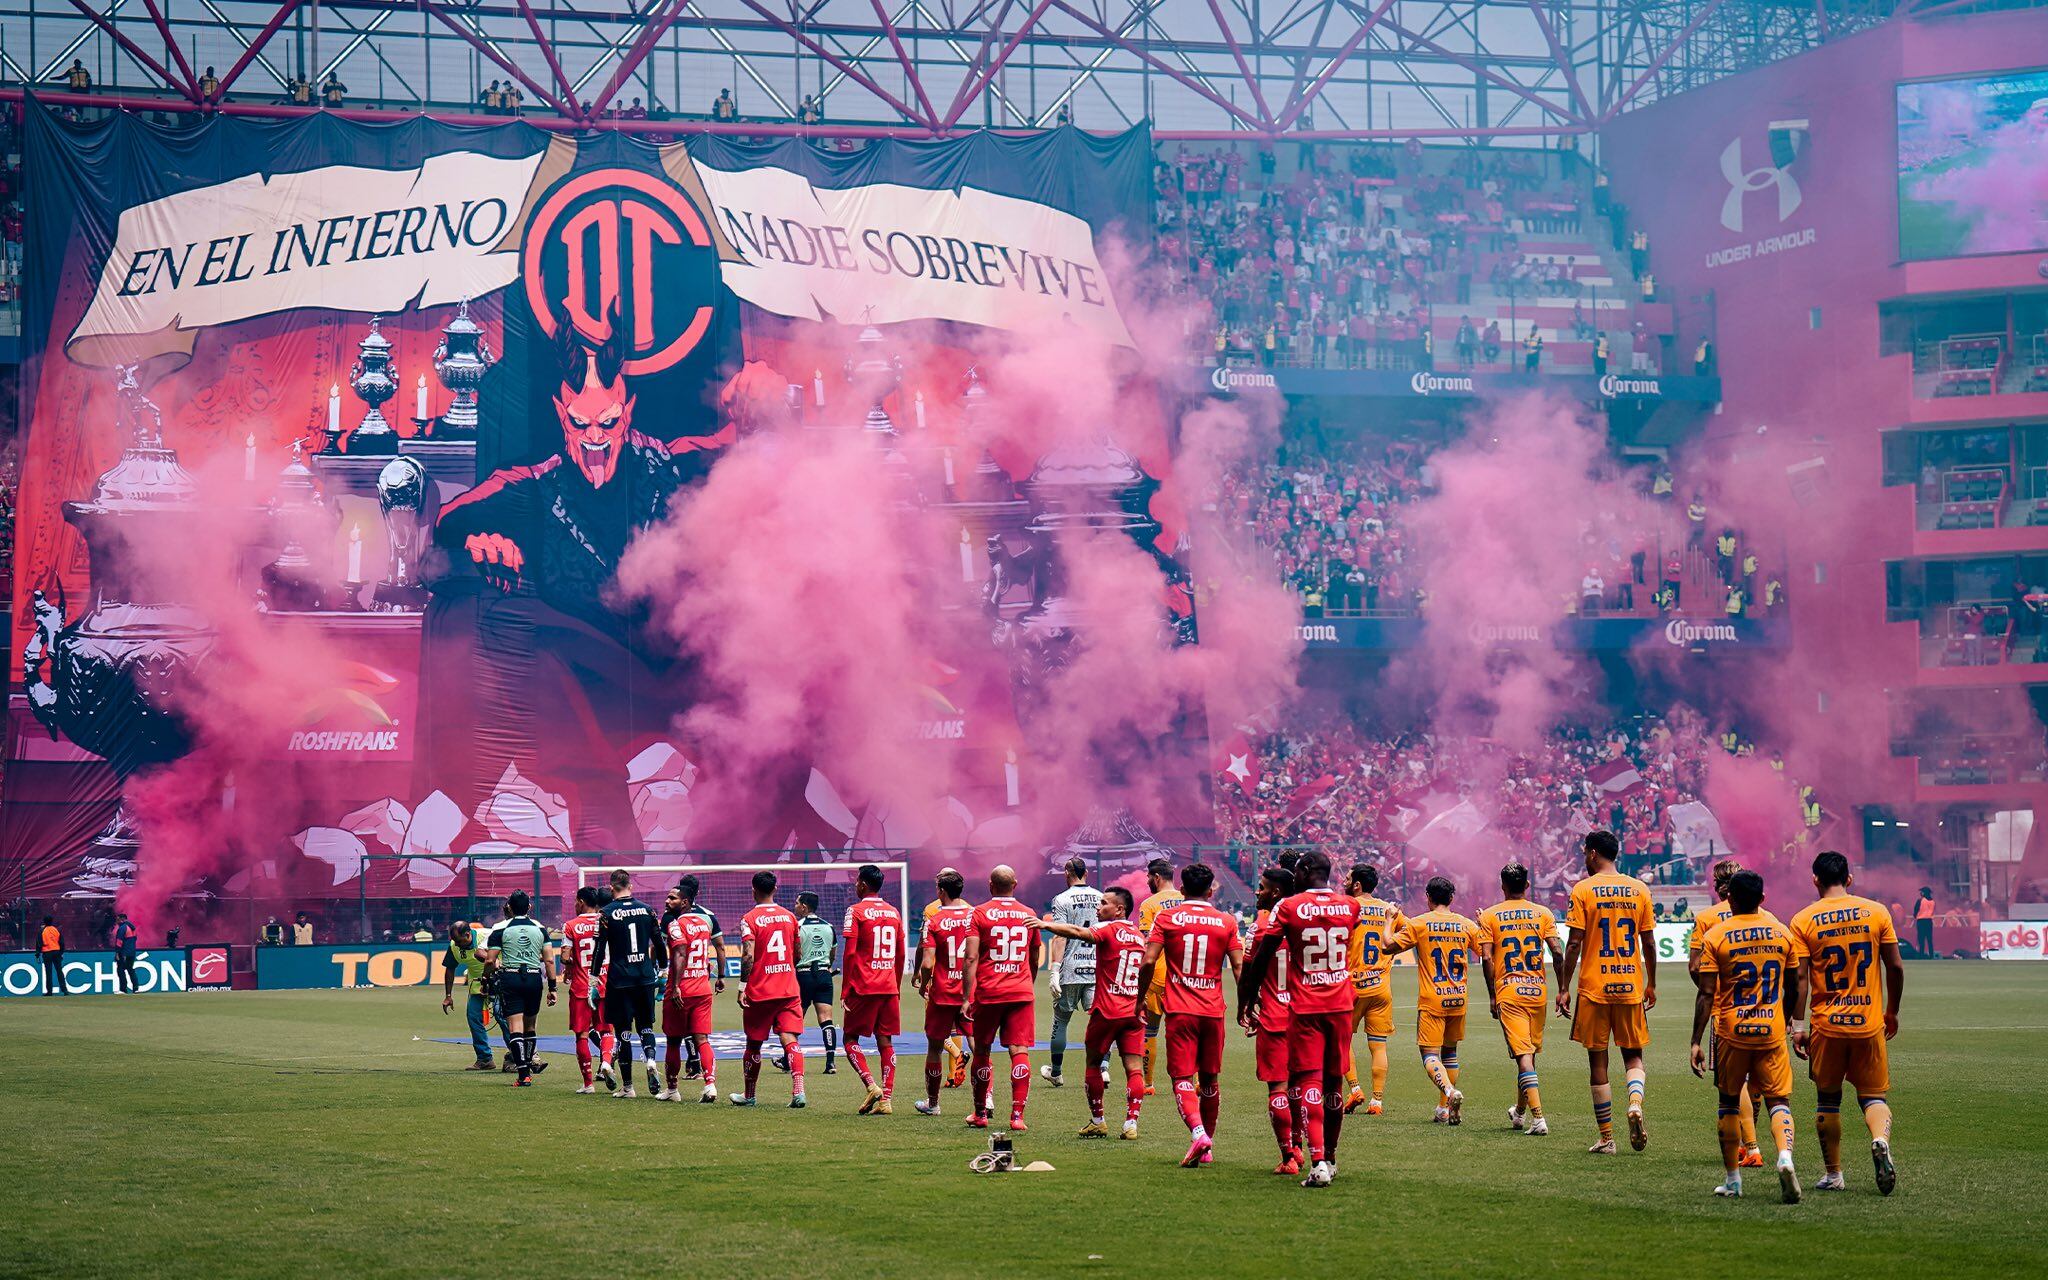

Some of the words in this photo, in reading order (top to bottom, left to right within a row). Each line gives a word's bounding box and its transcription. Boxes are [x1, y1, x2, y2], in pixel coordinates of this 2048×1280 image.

[116, 243, 198, 296] EN
[194, 233, 254, 287] EL
[263, 198, 507, 276] INFIERNO
[719, 205, 859, 272] NADIE
[862, 229, 1105, 307] SOBREVIVE
[1706, 244, 1751, 268] UNDER
[1756, 228, 1816, 256] ARMOUR
[1212, 367, 1275, 391] Corona
[1411, 371, 1473, 395] Corona
[1599, 374, 1659, 398] Corona
[1665, 619, 1737, 647] Corona
[288, 731, 399, 751] ROSHFRANS
[1071, 894, 1097, 903] TECATE
[1593, 887, 1632, 897] TECATE
[612, 907, 649, 920] Corona
[755, 915, 792, 927] Corona
[864, 908, 897, 920] Corona
[1172, 911, 1223, 927] Corona
[1297, 903, 1350, 920] Corona
[1496, 910, 1533, 921] TECATE
[1813, 908, 1861, 926] TECATE
[628, 923, 638, 953] 1
[1426, 922, 1461, 932] TECATE
[1598, 917, 1636, 957] 13
[1726, 928, 1773, 943] TECATE
[2006, 925, 2039, 948] de
[687, 939, 708, 968] 21
[767, 930, 786, 961] 4
[873, 926, 896, 958] 19
[990, 926, 1028, 961] 32
[1182, 933, 1208, 975] 11
[1302, 927, 1349, 972] 26
[1364, 932, 1380, 965] 6
[1502, 936, 1542, 972] 22
[1746, 946, 1780, 955] AFIRME
[516, 950, 534, 959] AT&T
[1431, 947, 1464, 982] 16
[1823, 942, 1872, 991] 27
[0, 952, 186, 996] OLCHÓN
[765, 964, 791, 974] HUERTA
[1115, 949, 1142, 987] 16
[1611, 965, 1635, 974] REYES
[1183, 976, 1215, 989] ARAUJO
[1734, 960, 1780, 1006] 20
[1737, 1009, 1774, 1018] AQUINO
